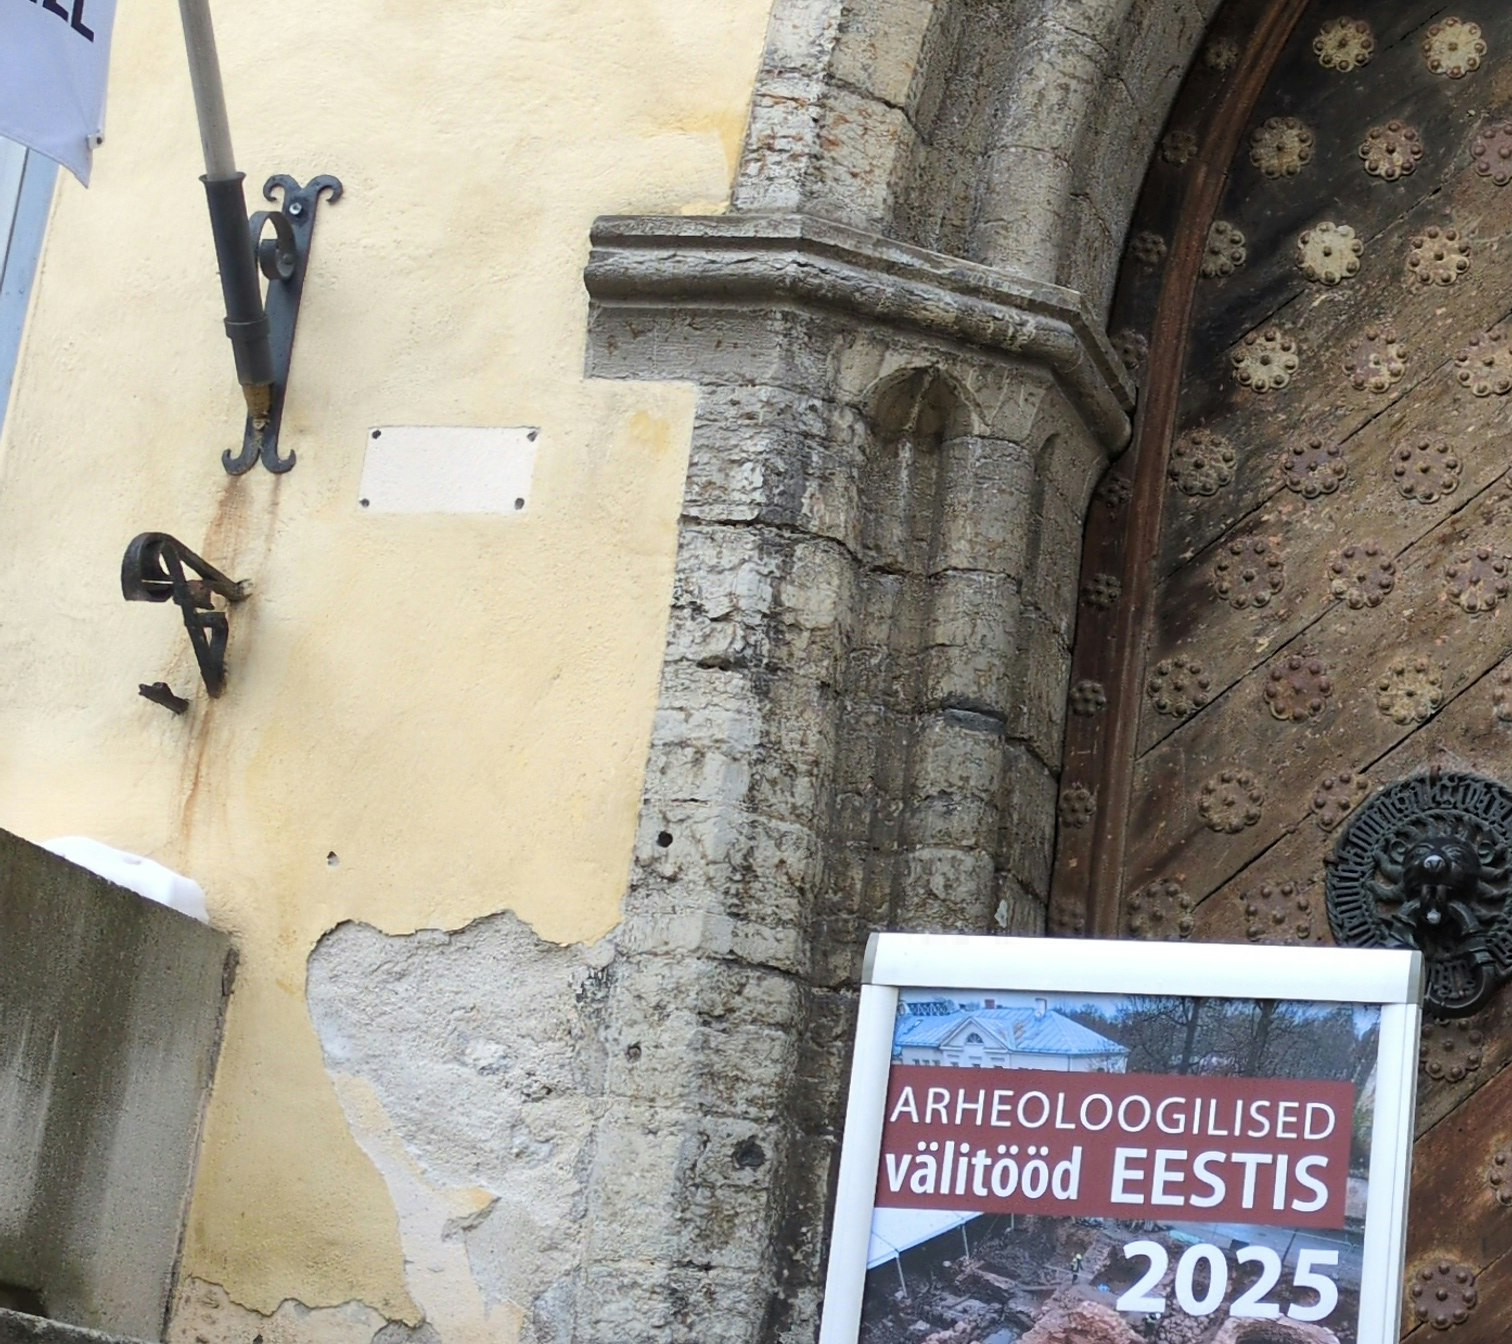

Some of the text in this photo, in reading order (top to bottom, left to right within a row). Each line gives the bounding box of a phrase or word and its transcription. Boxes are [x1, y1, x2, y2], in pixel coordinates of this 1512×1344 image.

[890, 1086, 1336, 1141] ARHEOLOOGILISED
[884, 1140, 1329, 1213] välitööd EESTIS
[1116, 1240, 1339, 1322] 2025
